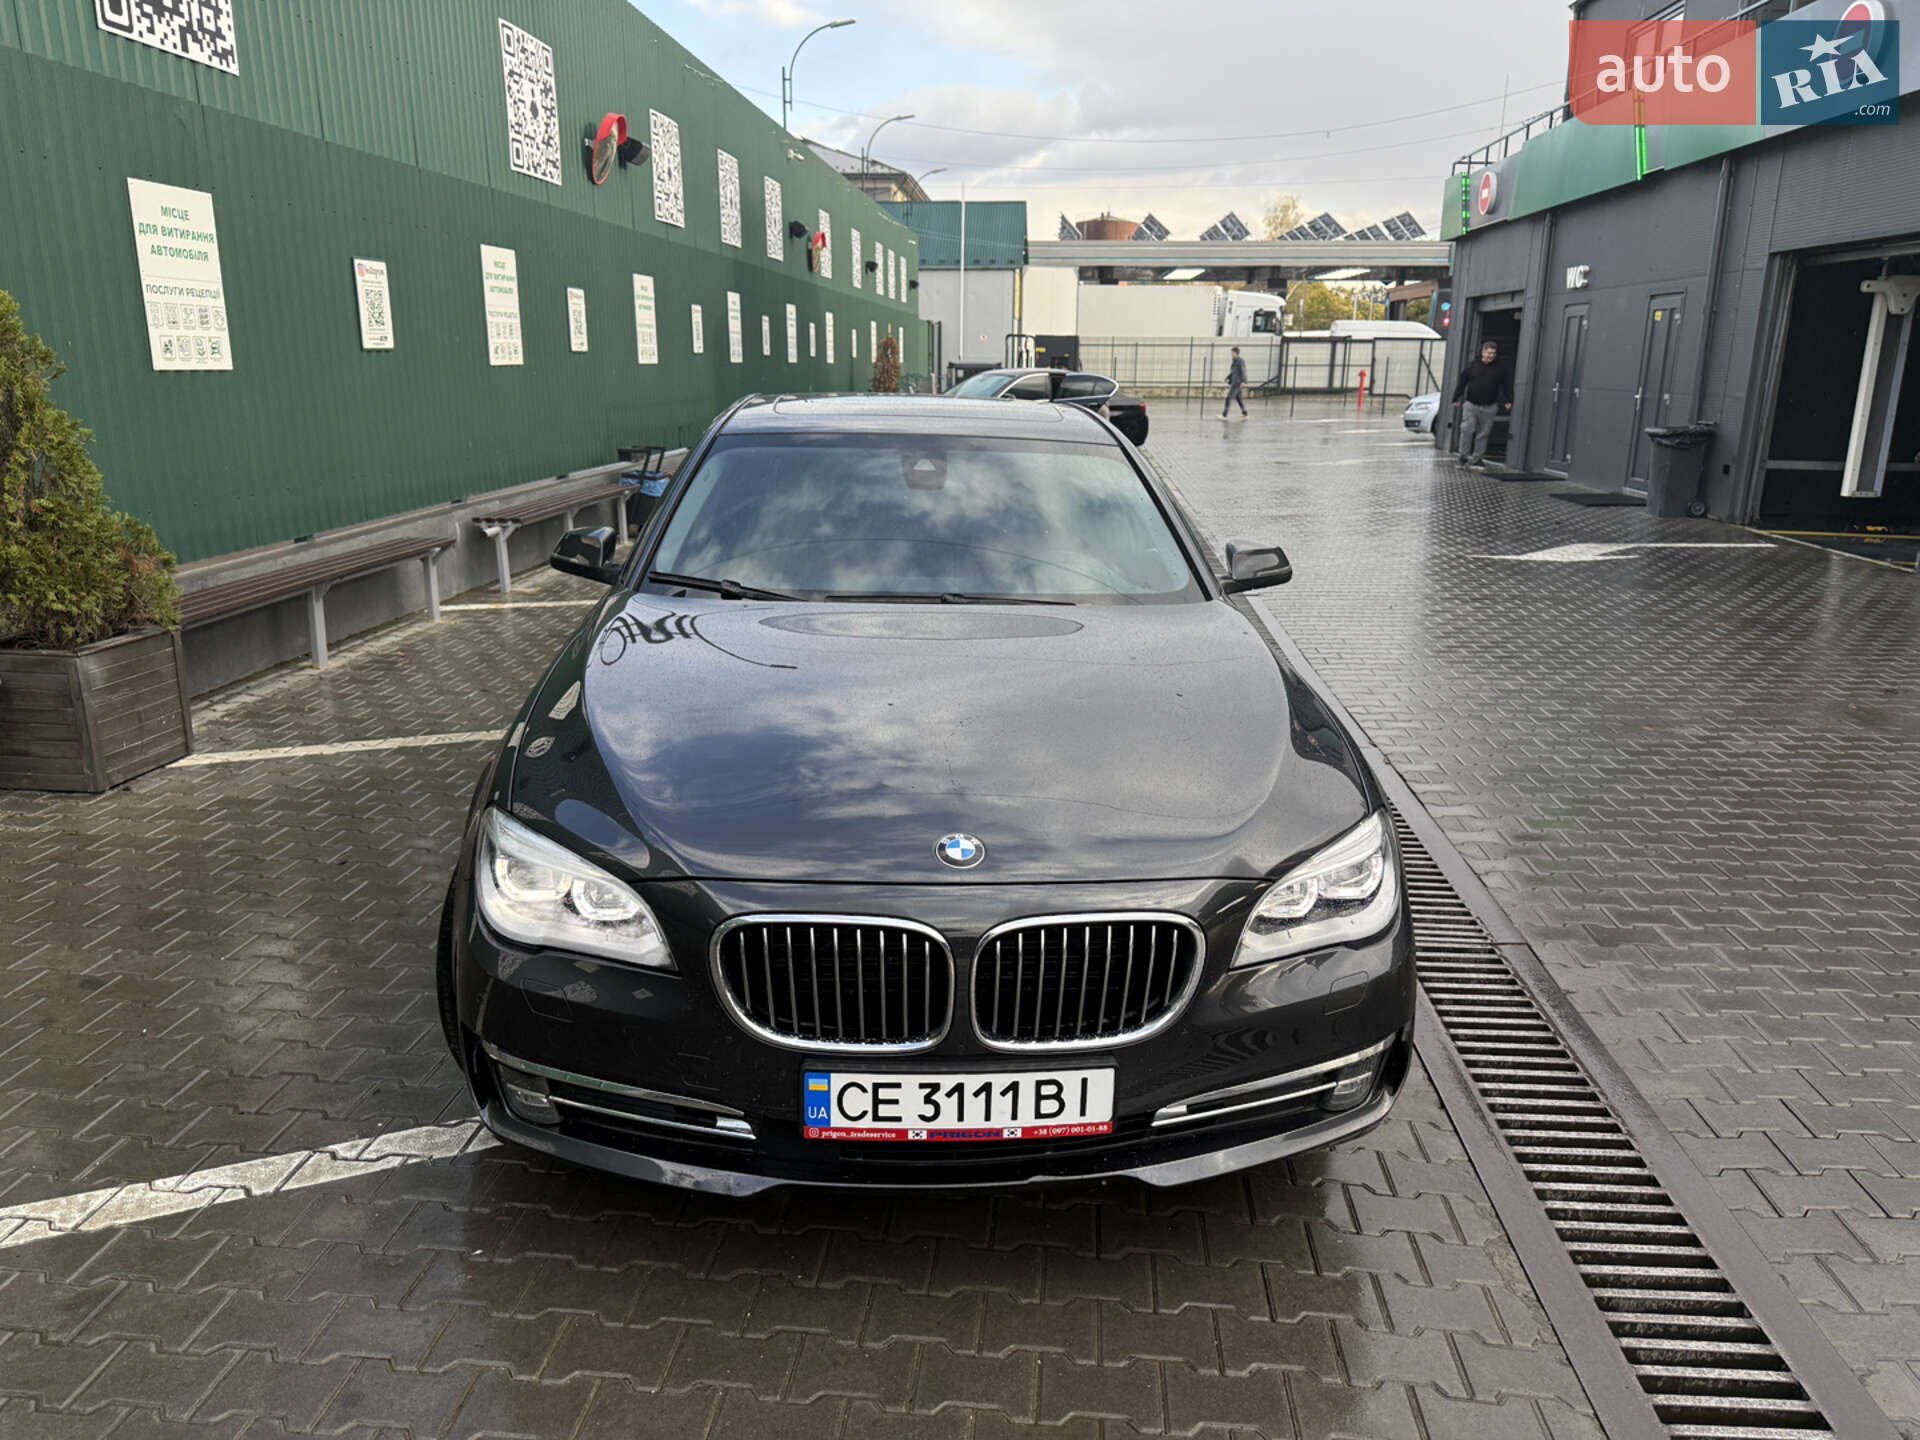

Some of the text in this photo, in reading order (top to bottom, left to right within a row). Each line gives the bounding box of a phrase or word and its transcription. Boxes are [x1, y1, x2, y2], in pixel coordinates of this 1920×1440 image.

[160, 205, 191, 222] МІСЦЕ
[138, 222, 215, 244] ДЛЯ ВИТИРАННЯ
[150, 244, 209, 262] АВТОМОБІЛЯ
[1566, 264, 1590, 289] WC
[145, 283, 185, 297] ПОСЛУГИ
[836, 1077, 1089, 1123] CE 3111 BI
[807, 1106, 828, 1119] UA
